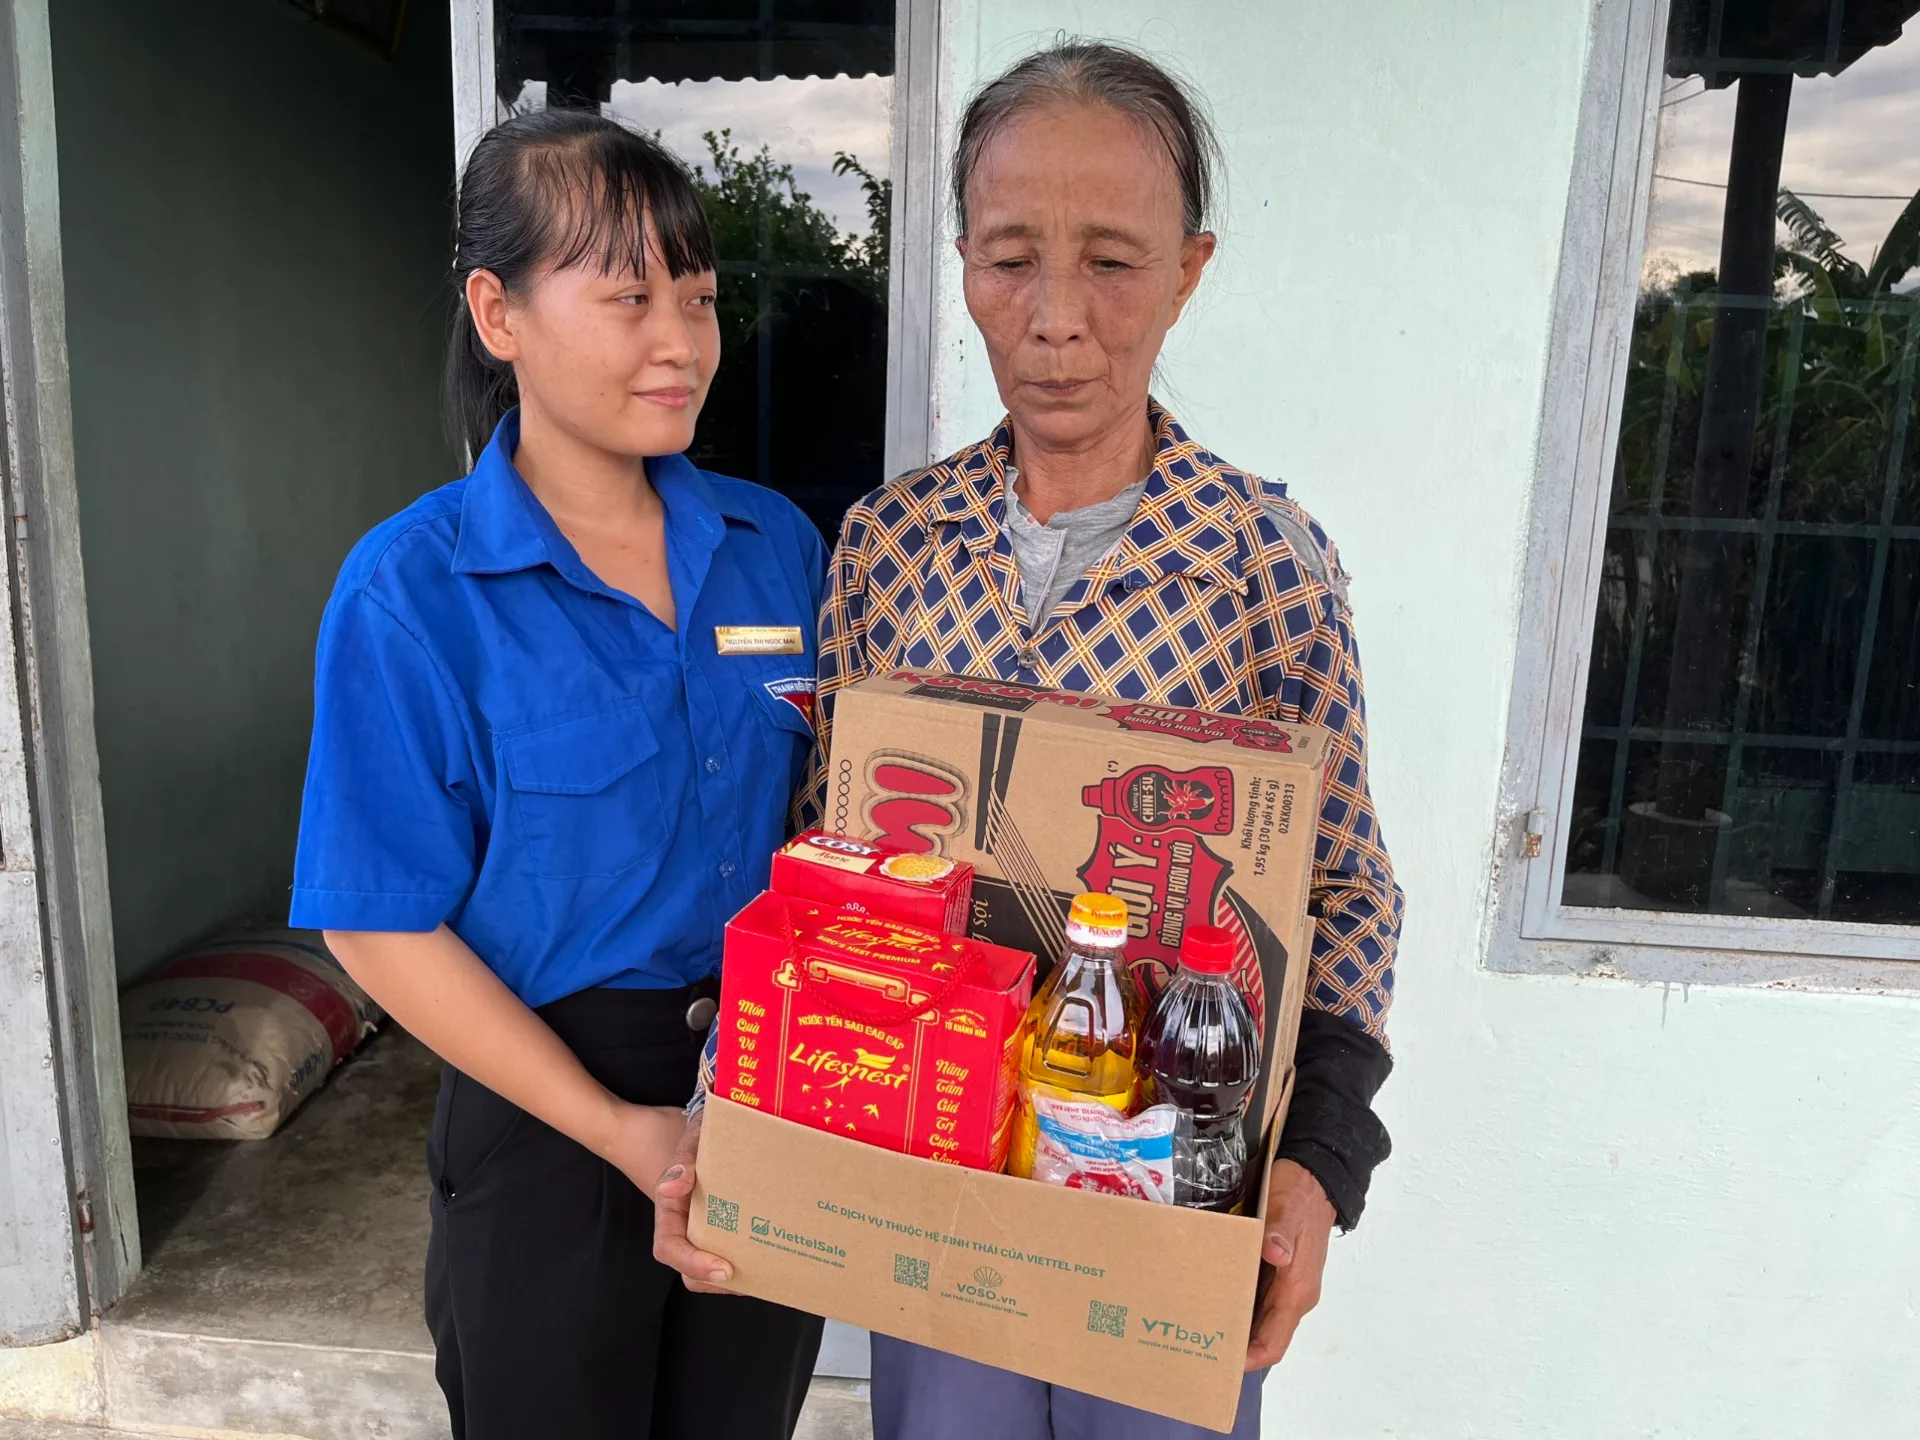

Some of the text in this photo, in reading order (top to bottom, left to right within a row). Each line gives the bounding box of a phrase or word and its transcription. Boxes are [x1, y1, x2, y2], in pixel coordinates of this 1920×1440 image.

[891, 671, 1101, 709] KOKOMI
[1132, 706, 1190, 723] GỢI
[1172, 723, 1203, 734] HƠN
[1266, 779, 1280, 791] g)
[1131, 792, 1139, 813] Tương
[1142, 776, 1155, 823] CHIN-SU
[1264, 791, 1276, 804] 65
[1240, 776, 1262, 850] Khối lượng tịnh:
[1261, 810, 1275, 826] gói
[1278, 783, 1296, 834] 02KK00313
[1260, 826, 1272, 843] (30
[808, 835, 878, 856] COSY
[1255, 843, 1270, 857] kg
[1253, 857, 1268, 877] 1,95
[1156, 840, 1195, 947] BÙNG VỊ HƠN VỚI
[970, 898, 992, 928] sợi
[824, 923, 934, 953] Lifesnest
[816, 934, 921, 964] BIRD'S NEST PREMIUM
[738, 999, 766, 1017] Món
[736, 1018, 761, 1035] Quà
[825, 1014, 843, 1027] YẾN
[844, 1020, 864, 1033] SAO
[865, 1026, 886, 1041] CAO
[885, 1035, 905, 1050] CẤP
[738, 1035, 757, 1052] Vô
[737, 1054, 760, 1070] Giá
[788, 1043, 908, 1090] Lifesnest
[935, 1059, 969, 1082] Nâng
[738, 1071, 757, 1088] Từ
[936, 1098, 961, 1114] Giá
[935, 1116, 958, 1134] Trị
[929, 1133, 959, 1152] Cuộc
[772, 1226, 847, 1258] ViettelSale
[817, 1199, 1106, 1279] CÁC DỊCH VỤ THUỘC HỆ SINH THÁI CỦA VIETTEL POST
[956, 1282, 1017, 1306] VOSO.vn
[1141, 1317, 1216, 1349] VTbay
